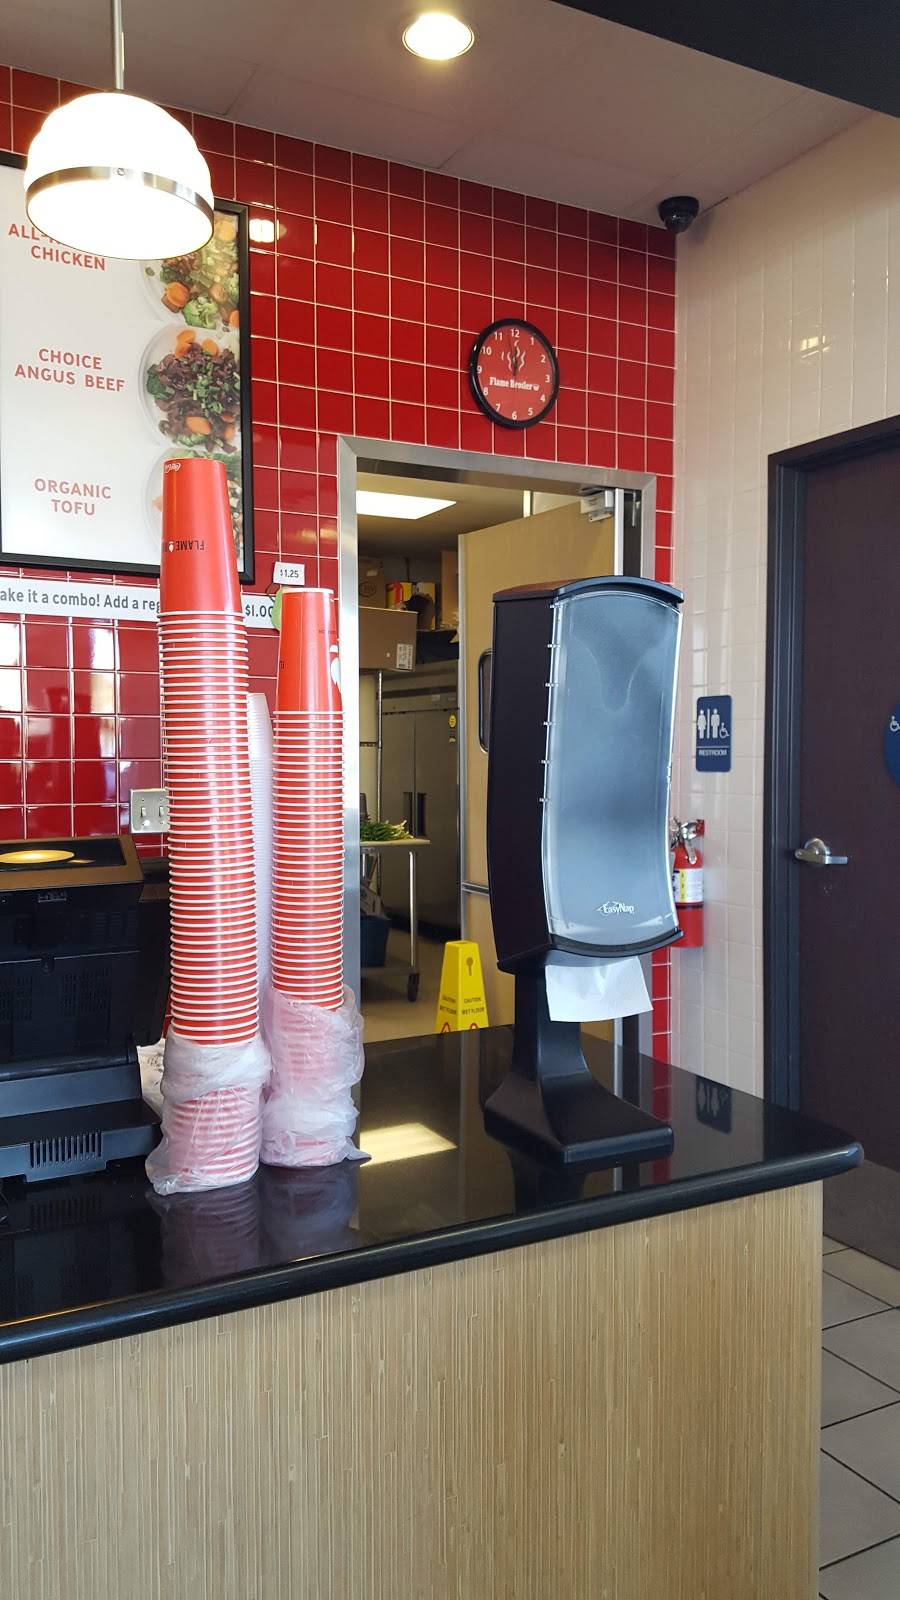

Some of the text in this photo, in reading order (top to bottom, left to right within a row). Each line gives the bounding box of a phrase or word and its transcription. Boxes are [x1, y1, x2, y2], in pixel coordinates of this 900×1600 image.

[8, 223, 61, 244] ALL-
[31, 245, 105, 270] CHICKEN
[494, 331, 503, 341] 11
[510, 329, 520, 338] 12
[530, 337, 534, 345] 1
[482, 346, 492, 355] 10
[38, 348, 103, 370] CHOICE
[541, 355, 545, 363] 2
[477, 365, 483, 374] 9
[15, 364, 126, 392] ANGUS BEEF
[489, 377, 509, 387] Flame
[545, 374, 550, 383] 3
[483, 387, 489, 396] 8
[540, 393, 546, 402] 4
[495, 403, 501, 412] 7
[527, 407, 533, 416] 5
[512, 411, 517, 420] 6
[34, 478, 112, 499] ORGANIC
[51, 499, 95, 516] TOFU
[176, 540, 205, 551] FLAME
[280, 568, 299, 579] $1.25
[28, 588, 38, 603] it
[41, 593, 49, 603] a
[52, 592, 100, 607] combo!
[104, 594, 129, 609] Add
[132, 600, 139, 609] a
